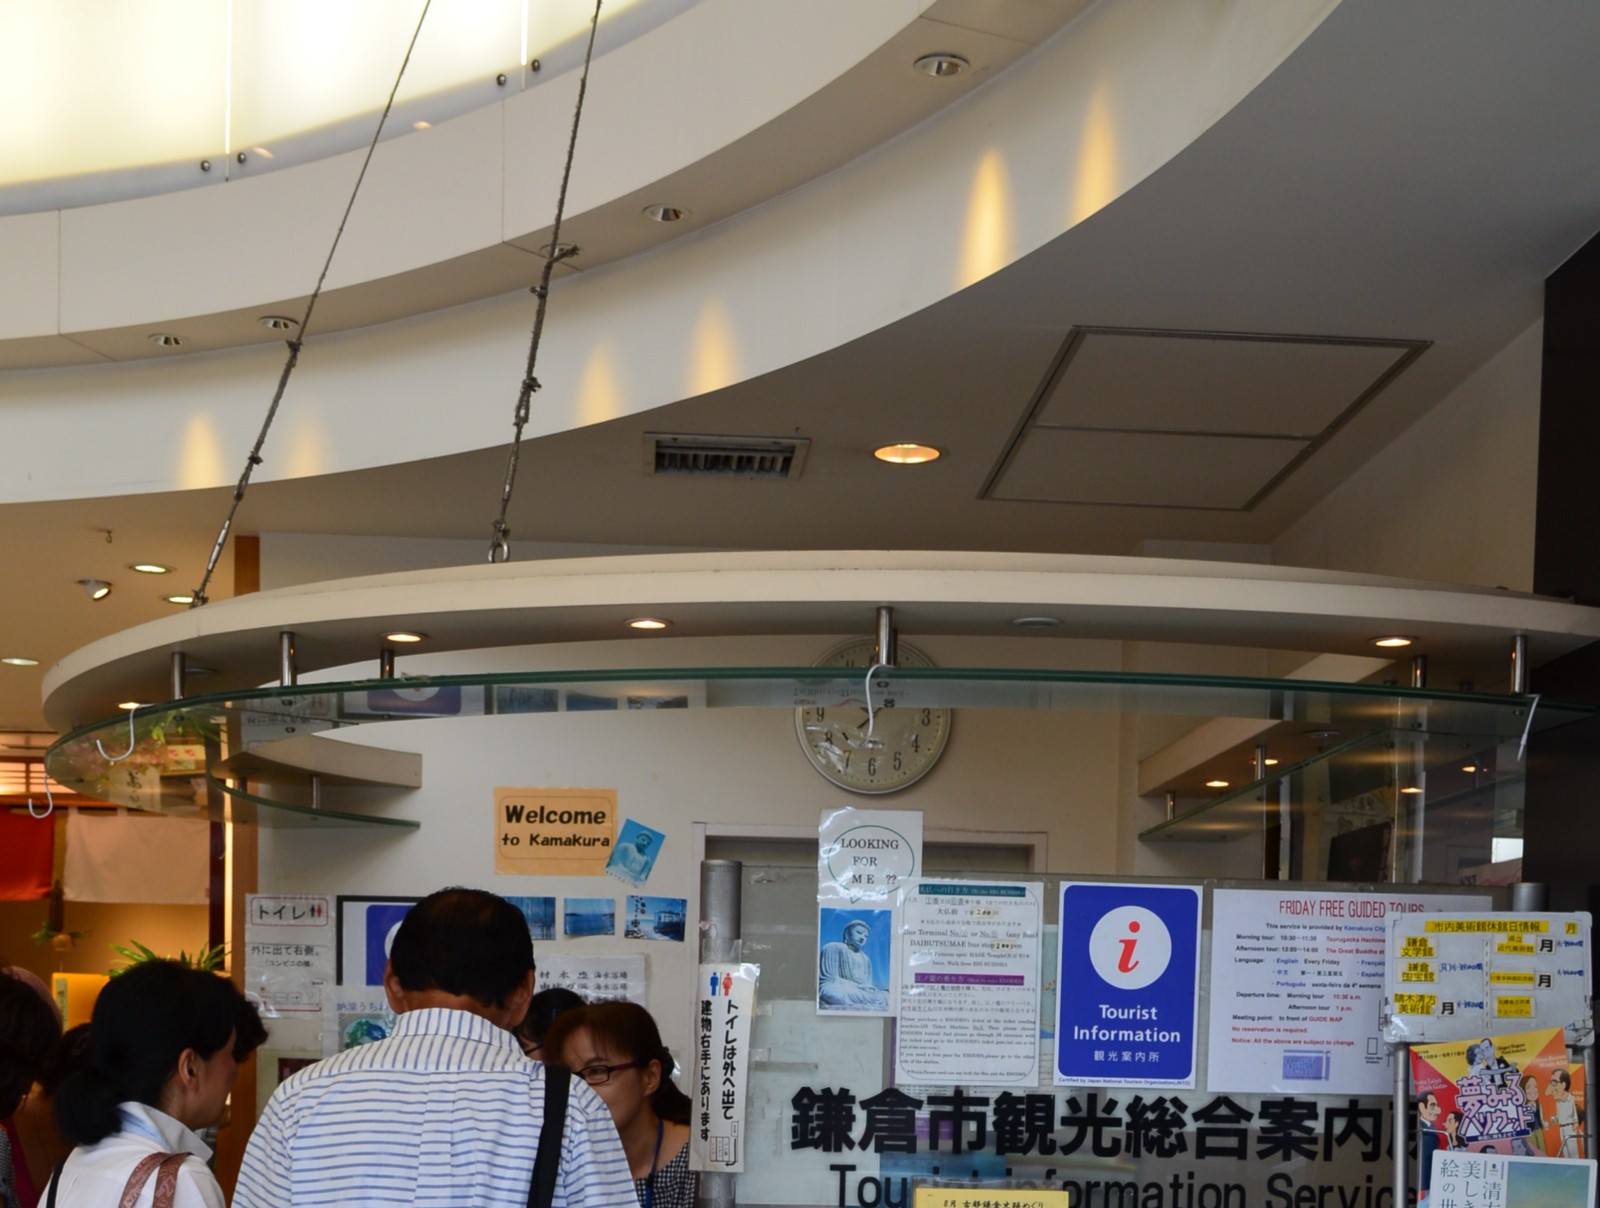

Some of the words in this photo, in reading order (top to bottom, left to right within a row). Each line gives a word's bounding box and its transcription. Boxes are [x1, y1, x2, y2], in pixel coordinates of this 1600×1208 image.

[505, 805, 606, 824] Welcome
[501, 833, 520, 847] to
[529, 833, 611, 847] Kamakura
[841, 838, 899, 850] LOOKING
[852, 856, 878, 867] FOR
[259, 905, 306, 920] トイレ
[1279, 900, 1316, 916] FRIDAY
[1319, 900, 1344, 918] FREE
[1348, 900, 1386, 918] GUIDED
[1336, 924, 1343, 932] by
[1374, 925, 1386, 933] City
[1434, 922, 1541, 932] 市内美術館休館日情報
[1565, 923, 1577, 934] 月
[918, 929, 948, 937] Terminal
[1236, 934, 1261, 942] Morning
[910, 939, 967, 948] DAIBUTSUMAE
[1406, 937, 1429, 947] 鎌倉
[1540, 939, 1553, 952] 月
[251, 945, 320, 956] 外に出て右側。
[1401, 947, 1434, 957] 文学館
[1321, 958, 1341, 966] Friday
[1408, 962, 1429, 972] 鎌倉
[1402, 972, 1435, 982] 国宝館
[1538, 974, 1552, 988] 月
[1287, 992, 1312, 1000] Morning
[1098, 1004, 1158, 1021] Tourist
[1397, 1004, 1432, 1015] 美術館
[1441, 1001, 1455, 1015] 月
[1073, 1025, 1181, 1043] Information
[721, 1000, 739, 1121] トイレは外へ出て
[1093, 1050, 1160, 1063] 観光案内所
[700, 1000, 713, 1142] 建物右手にあります
[1455, 1073, 1527, 1109] 夢みる
[1457, 1104, 1535, 1136] ハリウッド
[943, 1199, 958, 1208] 8月
